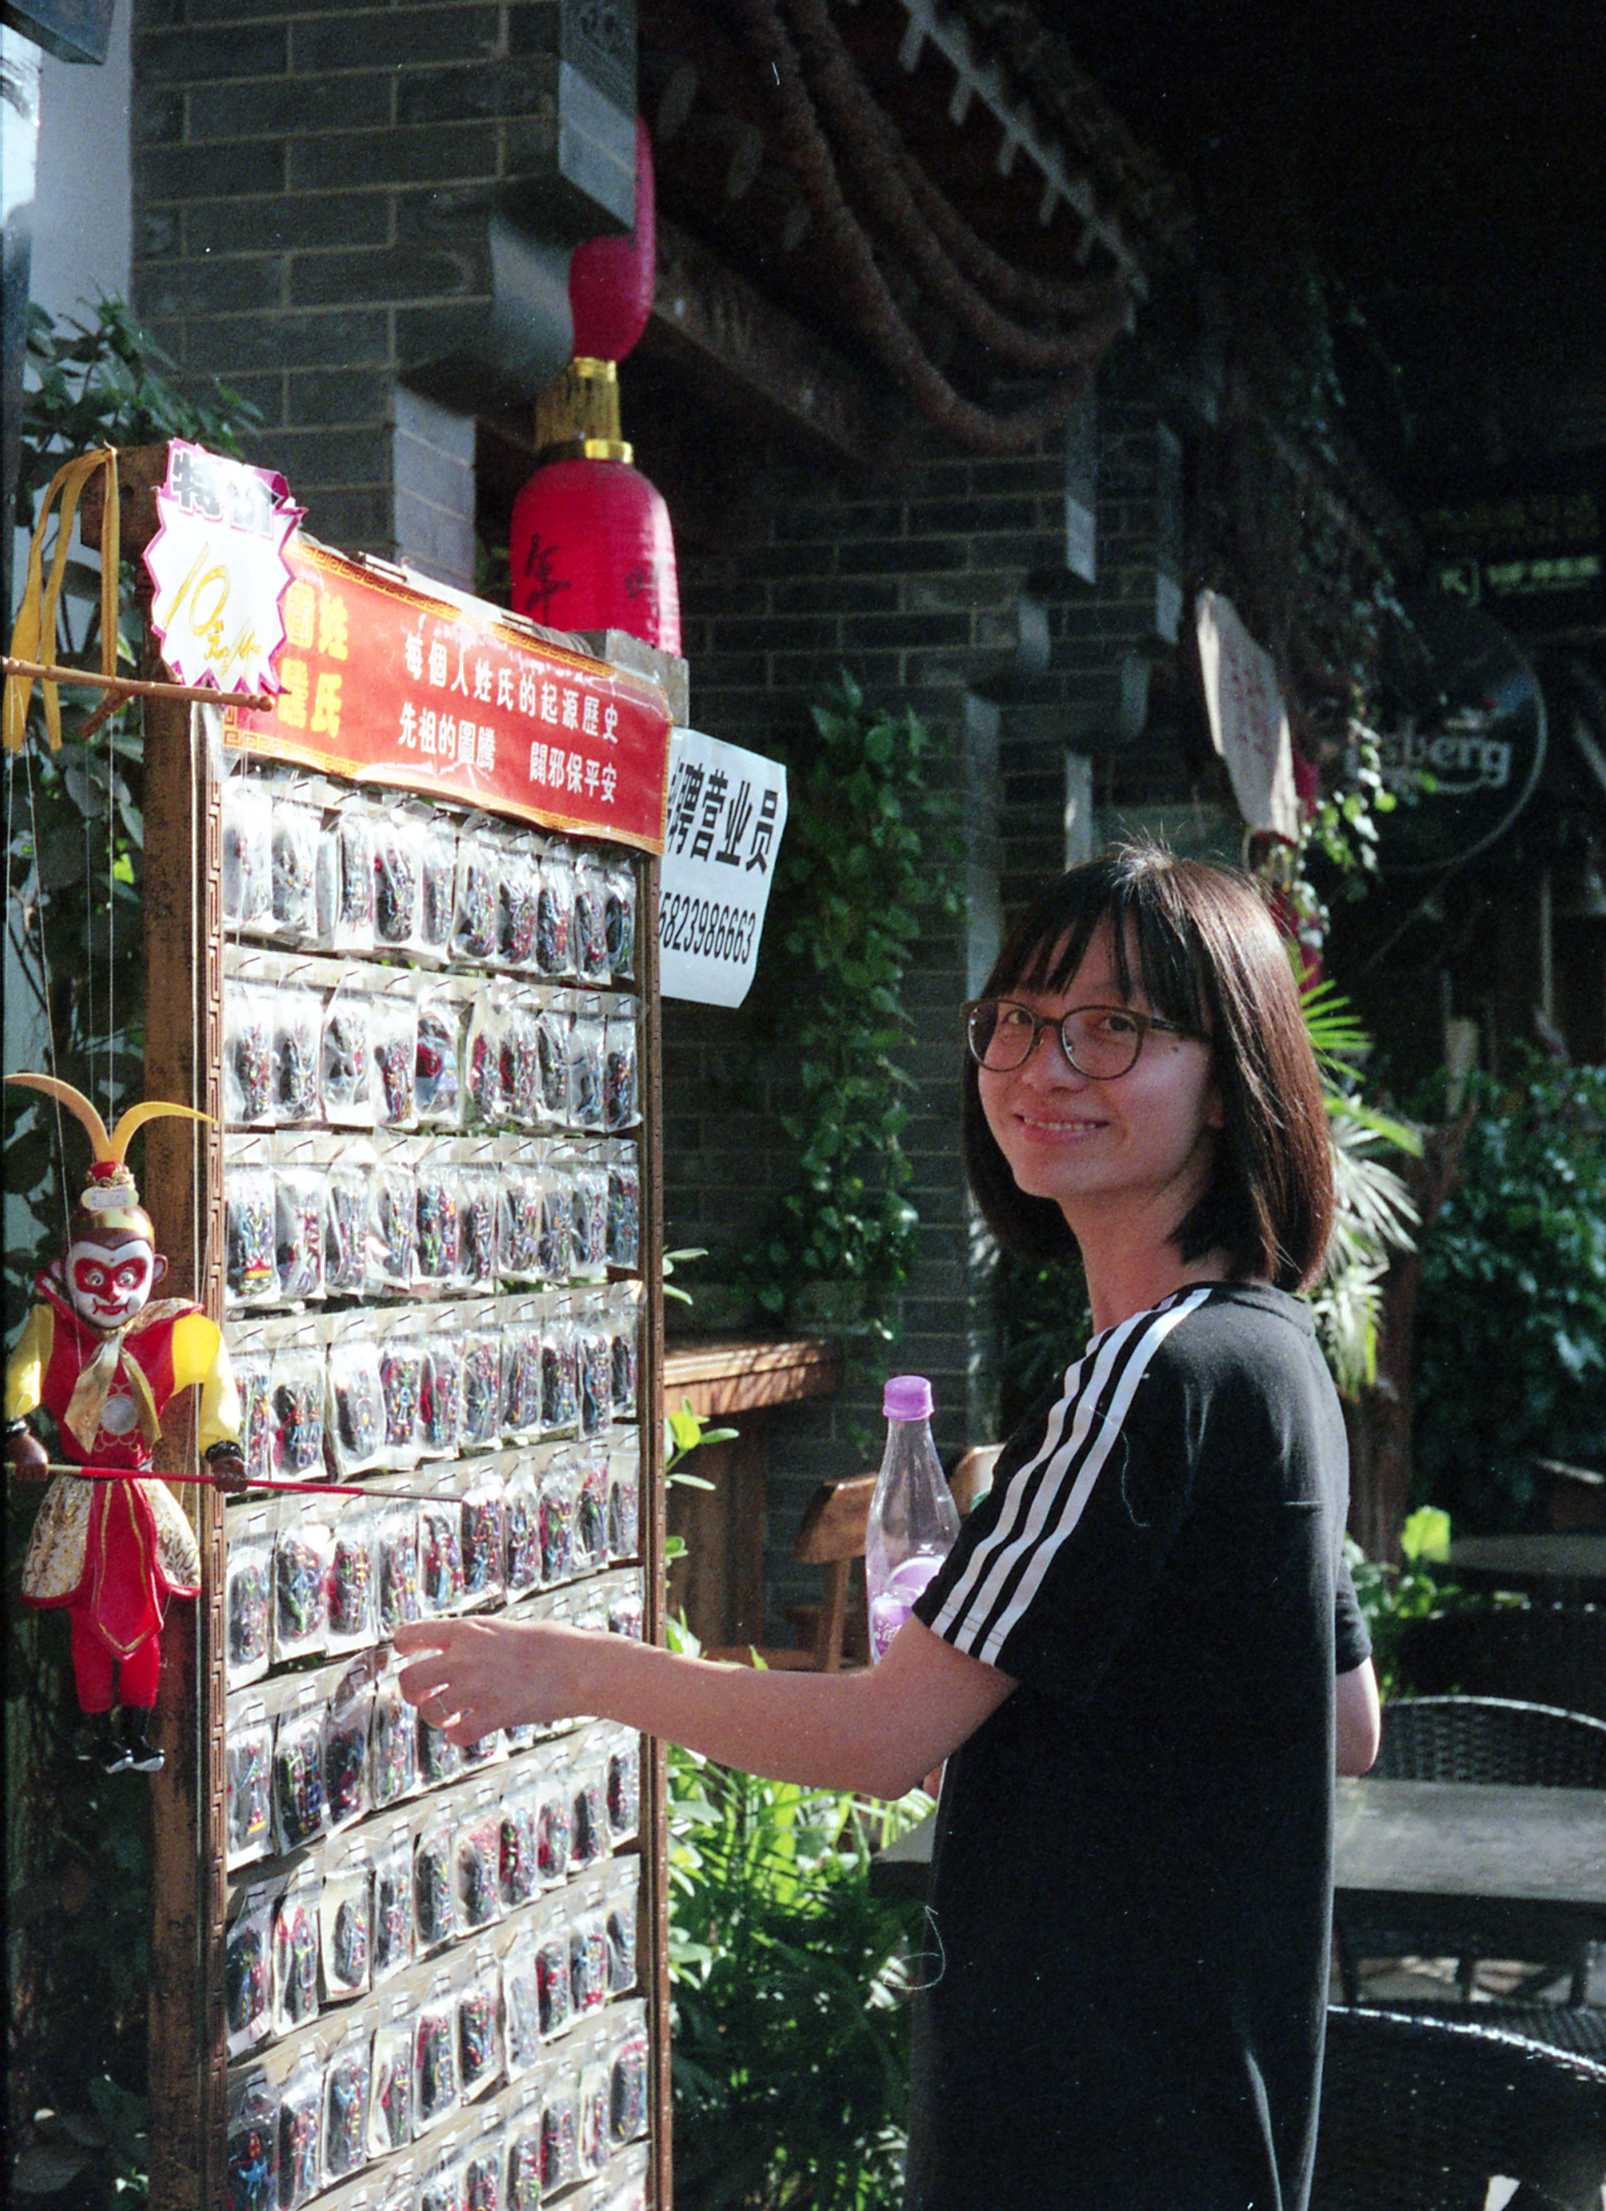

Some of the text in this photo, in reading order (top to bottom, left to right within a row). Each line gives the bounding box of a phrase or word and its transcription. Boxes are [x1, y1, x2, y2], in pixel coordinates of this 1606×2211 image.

[404, 630, 619, 745] 每個人姓氏的起源歷史
[397, 701, 496, 772] 先祖的圖騰
[659, 889, 756, 965] 5823986663
